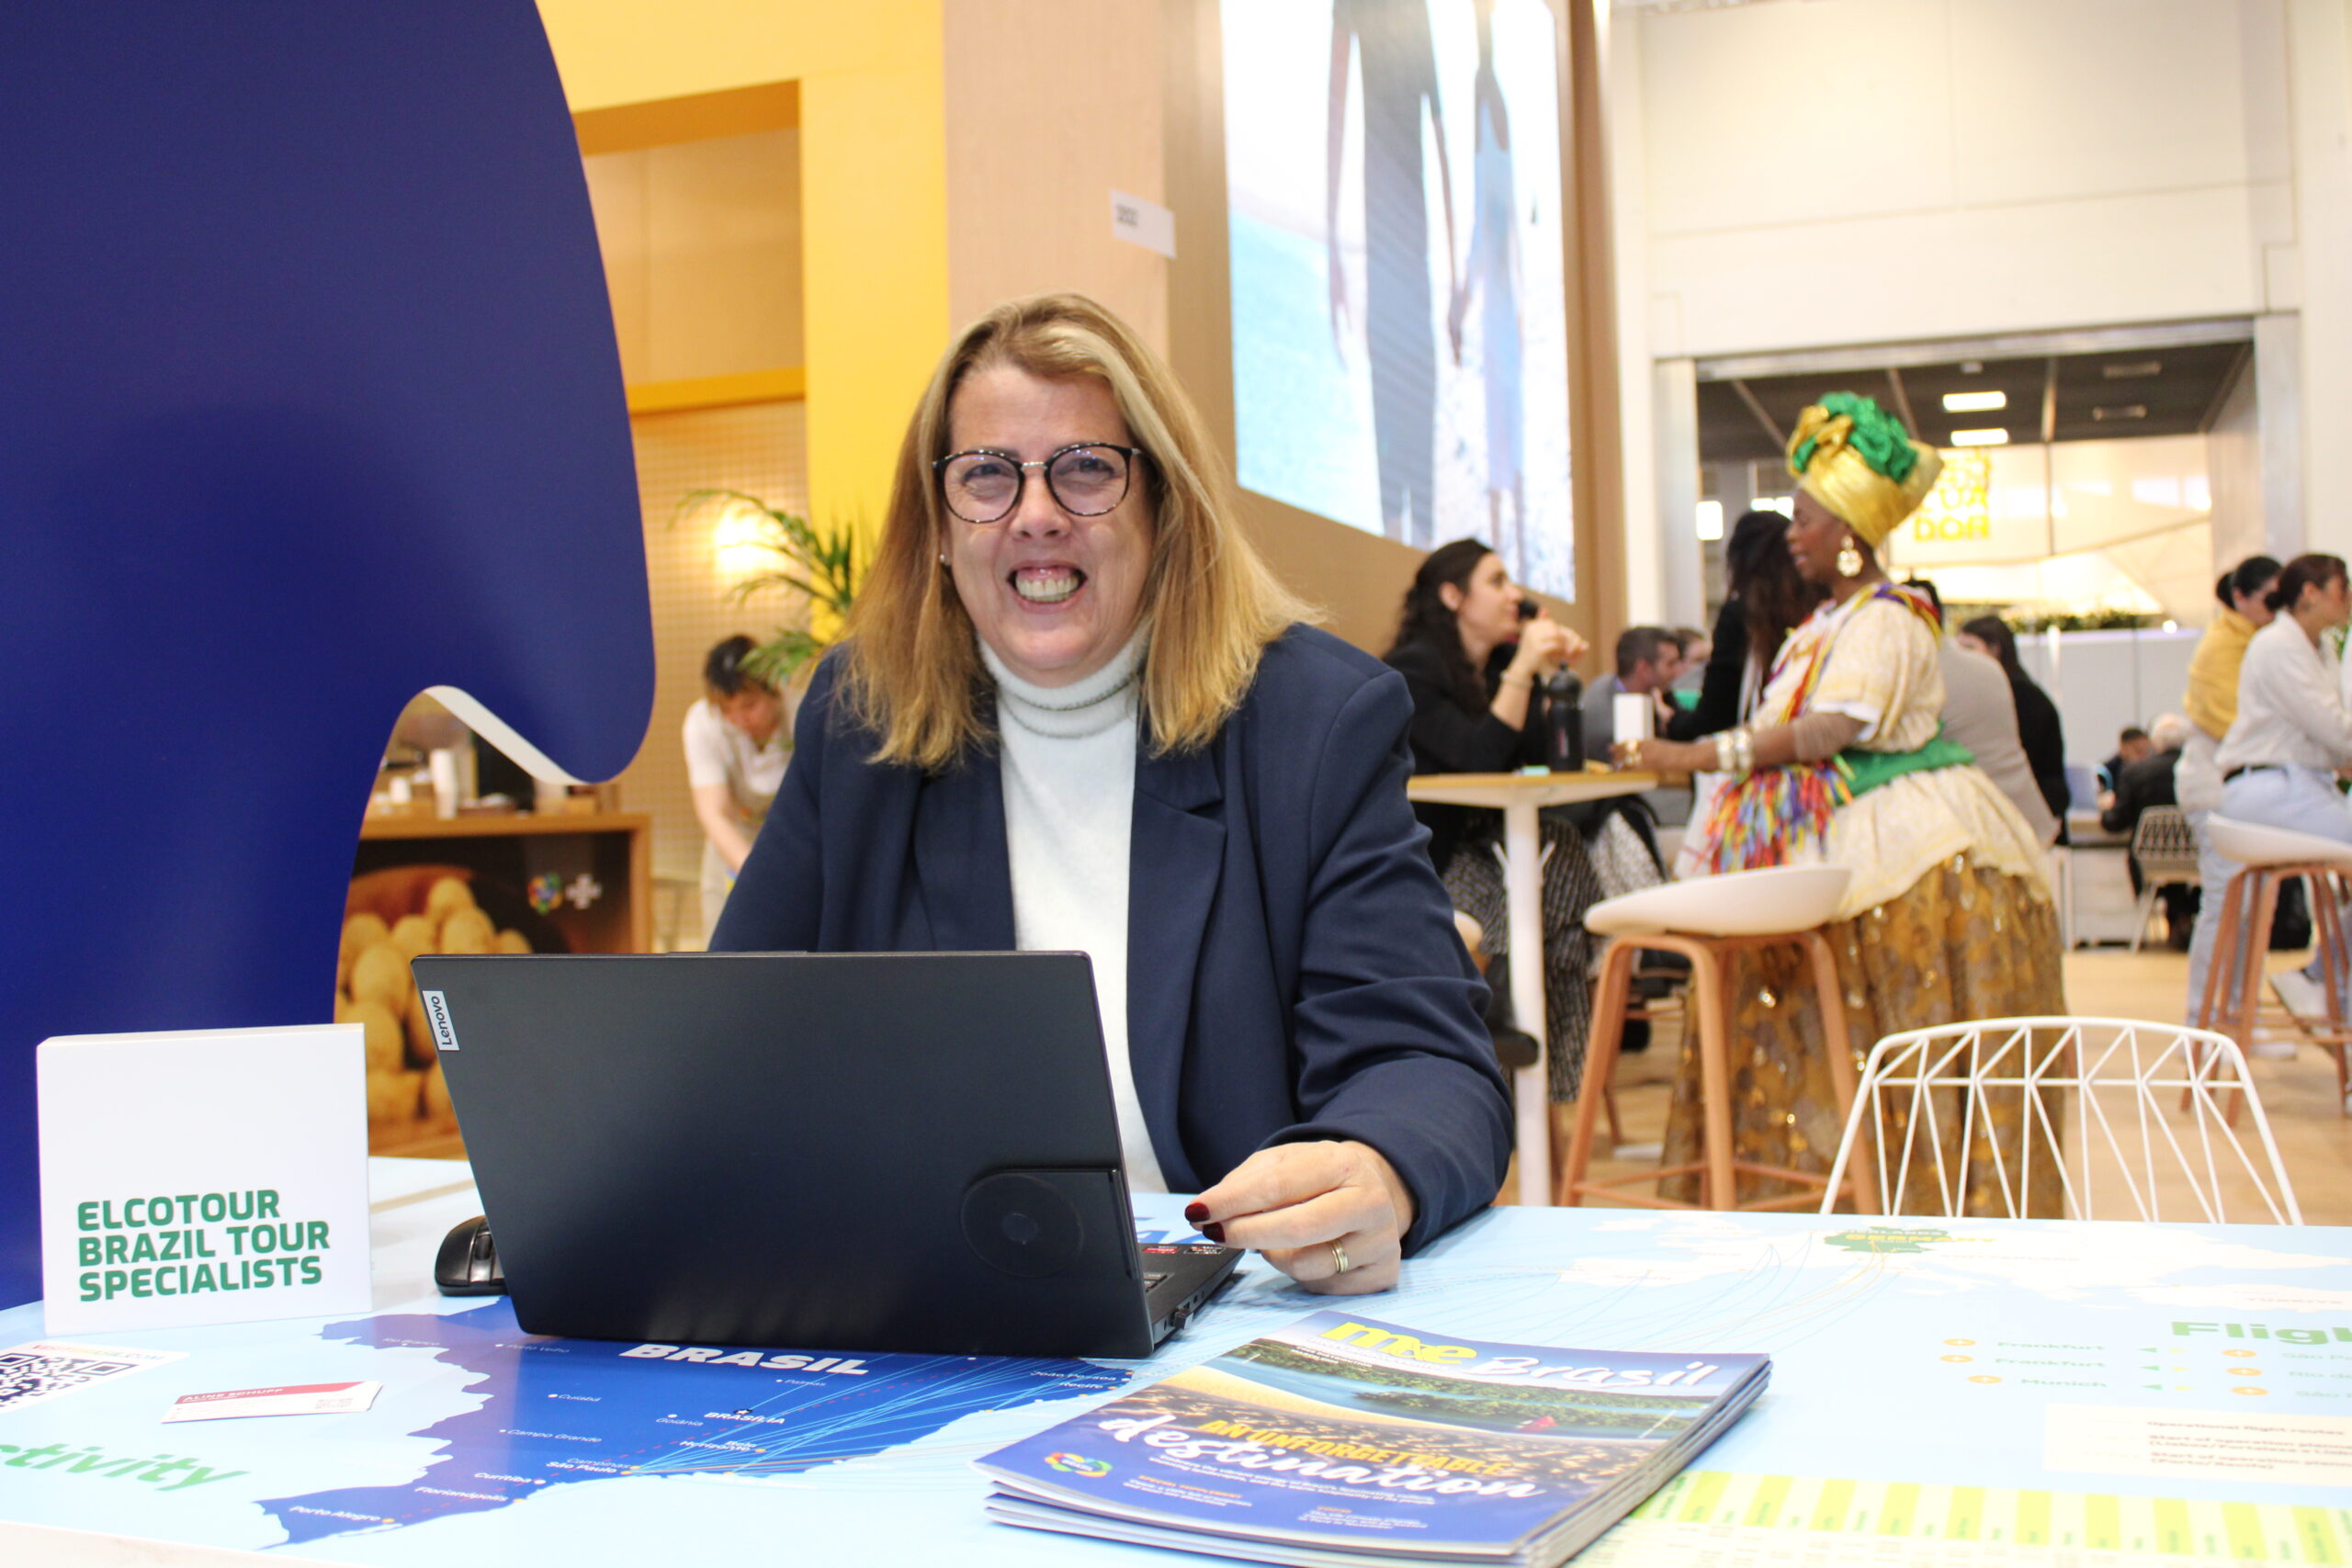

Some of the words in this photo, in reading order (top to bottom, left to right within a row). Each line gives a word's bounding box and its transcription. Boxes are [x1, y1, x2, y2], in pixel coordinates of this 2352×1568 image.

[431, 996, 453, 1045] Lenovo
[77, 1189, 280, 1232] ELCOTOUR
[78, 1228, 216, 1267] BRAZIL
[226, 1220, 331, 1256] TOUR
[79, 1255, 322, 1303] SPECIALISTS
[1997, 1341, 2105, 1350] Frankfurt
[618, 1344, 869, 1375] BRASIL
[1995, 1358, 2106, 1367] Frankfurt
[1461, 1356, 1720, 1388] Brasil
[2020, 1378, 2107, 1388] Munich
[655, 1417, 704, 1427] Goiânia
[506, 1429, 553, 1438] Campo
[554, 1433, 603, 1442] Grande
[1198, 1419, 1254, 1438] AN
[1245, 1429, 1514, 1474] UNFORGETTABLE
[566, 1458, 631, 1469] Campinas
[1098, 1414, 1547, 1498] destination
[546, 1461, 577, 1470] São
[576, 1464, 617, 1473] Paulo
[474, 1472, 533, 1483] Curitiba
[413, 1486, 508, 1502] Florianópolis
[289, 1506, 332, 1516] Porto
[333, 1511, 382, 1522] Alegre
